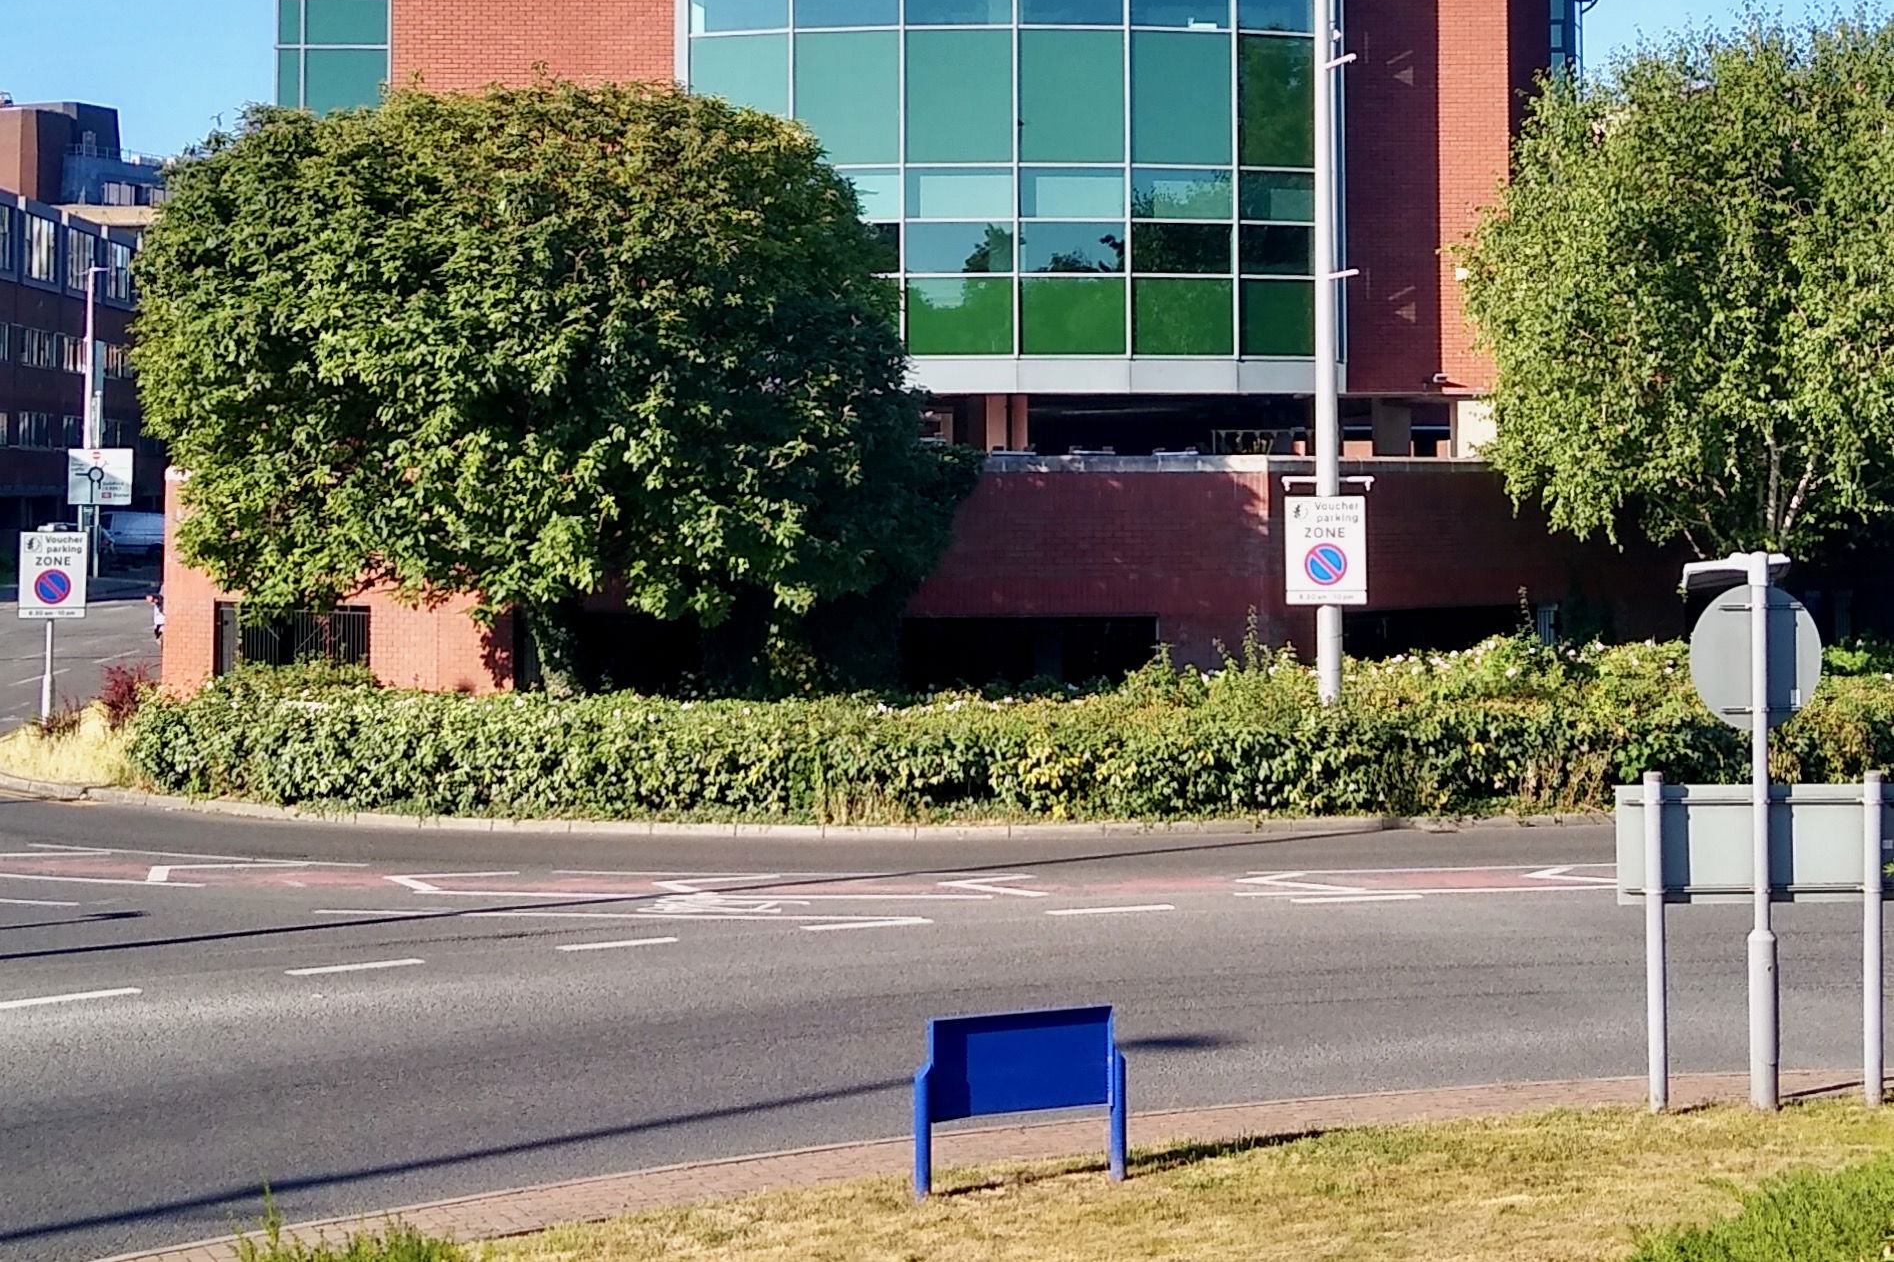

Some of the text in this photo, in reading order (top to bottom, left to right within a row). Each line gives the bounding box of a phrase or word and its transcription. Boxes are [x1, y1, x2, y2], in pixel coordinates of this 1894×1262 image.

[1314, 501, 1359, 511] Voucher
[1316, 513, 1359, 524] parking
[1304, 527, 1346, 539] ZONE
[45, 535, 83, 544] Voucher
[46, 545, 82, 555] parking
[35, 556, 72, 566] ZONE
